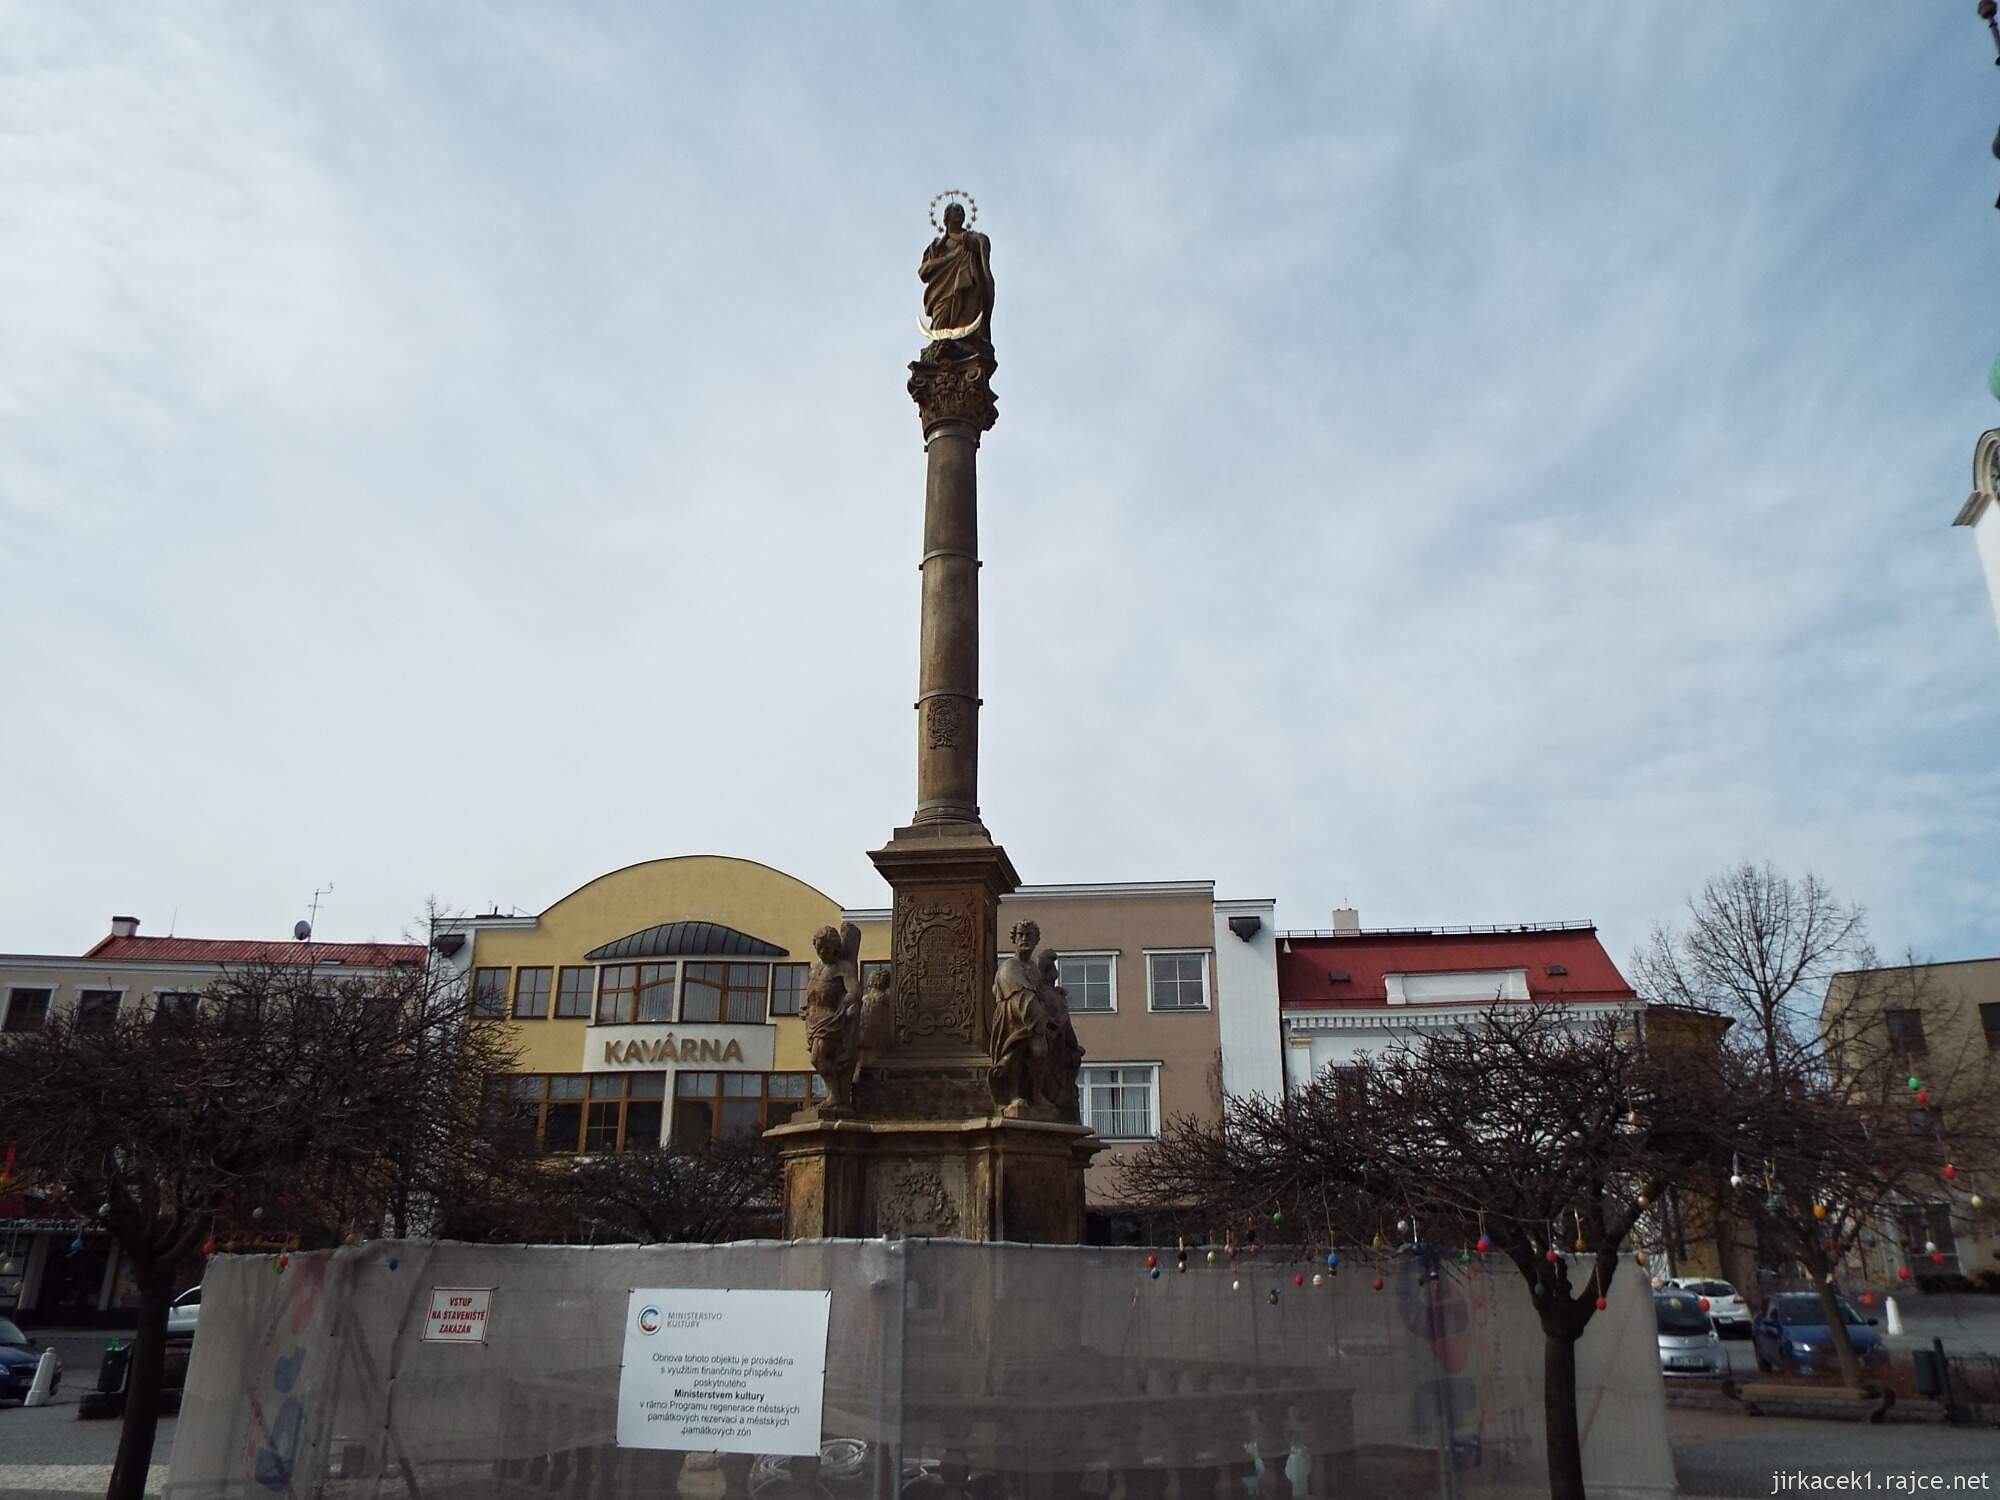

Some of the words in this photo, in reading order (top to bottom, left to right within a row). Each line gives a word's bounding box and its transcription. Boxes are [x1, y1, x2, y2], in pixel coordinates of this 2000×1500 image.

[605, 1032, 743, 1064] KAVÁRNA
[449, 1297, 473, 1306] VSTUP
[431, 1311, 441, 1320] NA
[667, 1311, 722, 1320] MINISTERSTVO
[666, 1320, 700, 1328] KULTURY
[653, 1353, 683, 1362] Obnova
[685, 1354, 709, 1363] tohoto
[711, 1355, 740, 1366] objektu
[741, 1357, 749, 1366] je
[751, 1355, 794, 1366] prováděna
[667, 1366, 700, 1376] využitím
[702, 1366, 742, 1377] finančního
[744, 1367, 783, 1378] příspěvku
[694, 1378, 747, 1389] poskytnutého
[674, 1389, 733, 1400] Ministerstvem
[735, 1391, 765, 1402] kultury
[646, 1400, 668, 1409] rámci
[670, 1400, 708, 1412] Programu
[711, 1403, 755, 1413] regenerace
[757, 1404, 800, 1415] městských
[647, 1411, 700, 1424] památkových
[702, 1414, 738, 1424] rezervací
[747, 1415, 790, 1428] městských
[737, 1427, 752, 1437] zón
